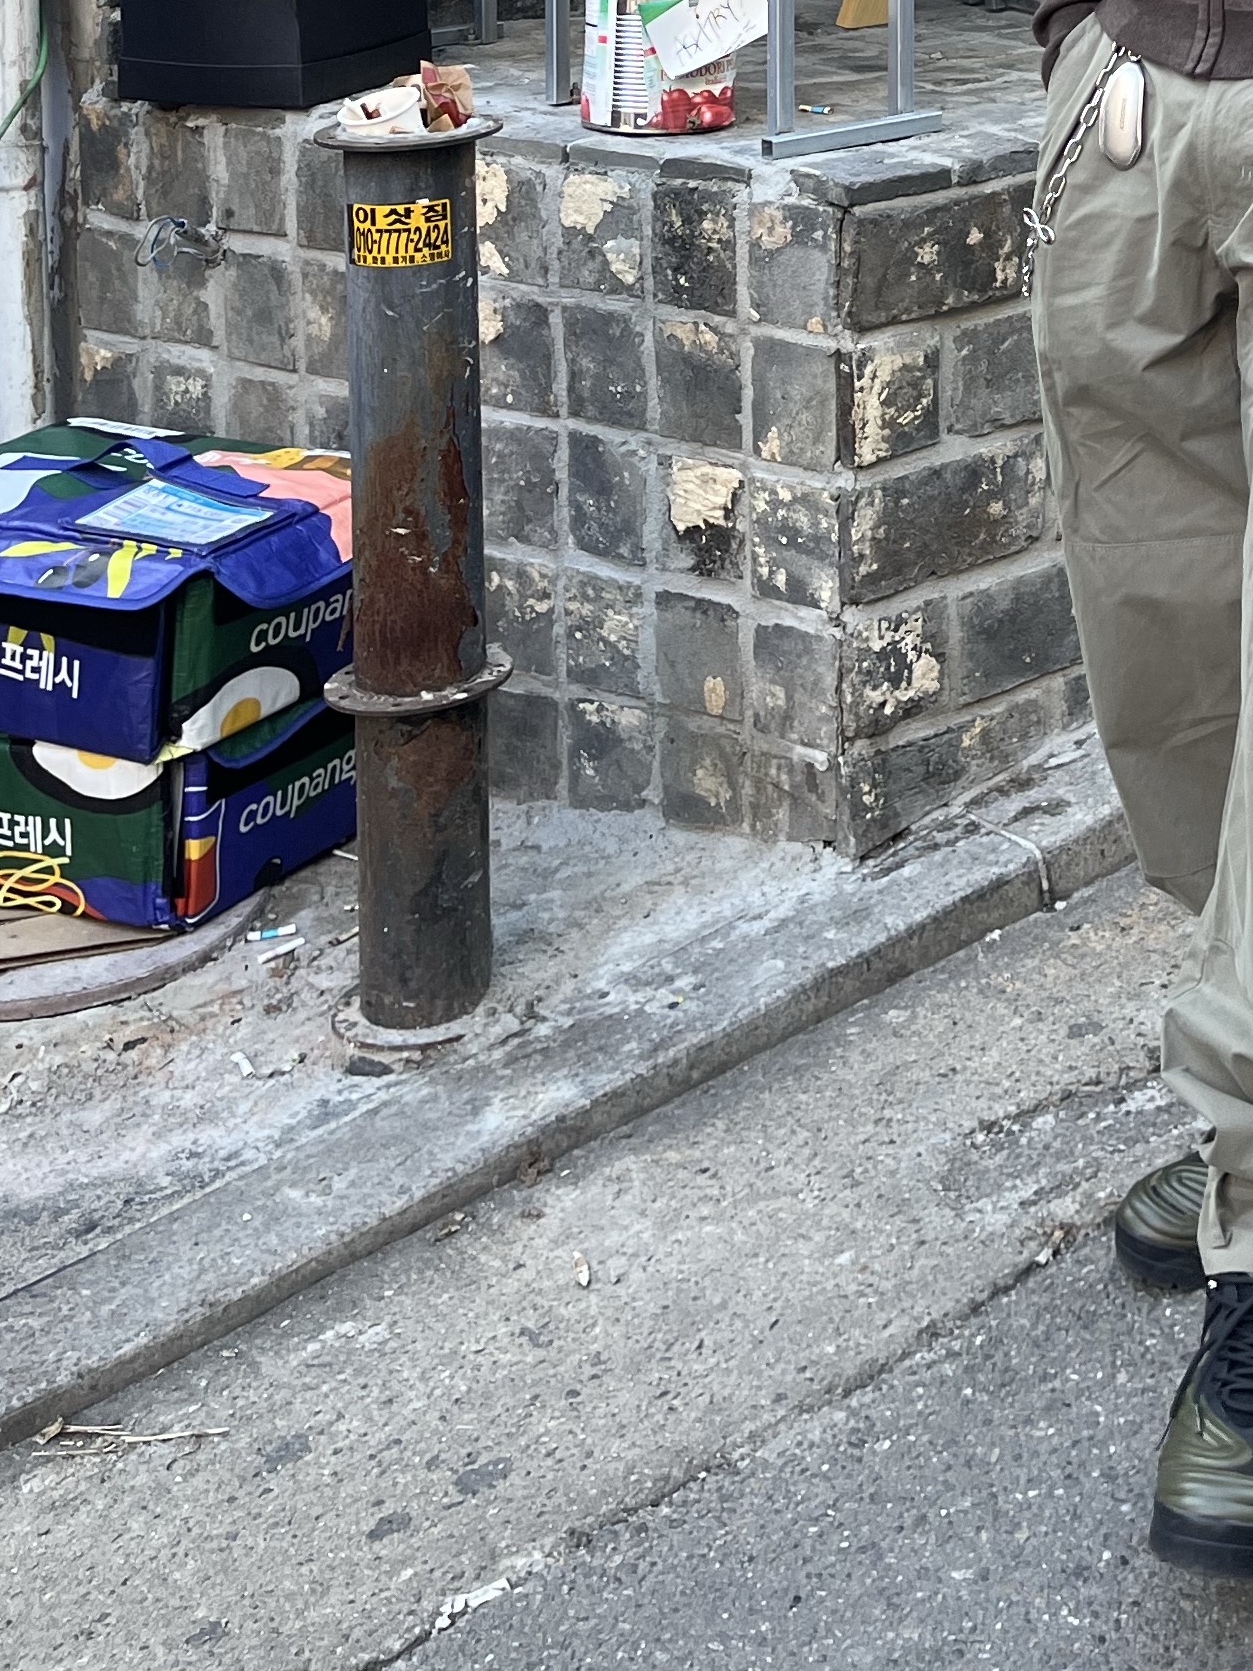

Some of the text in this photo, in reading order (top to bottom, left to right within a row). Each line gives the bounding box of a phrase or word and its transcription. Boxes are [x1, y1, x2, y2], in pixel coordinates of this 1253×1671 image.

[355, 222, 450, 255] 010-7777-2424
[0, 641, 80, 700] 프레시
[239, 747, 356, 834] coupang
